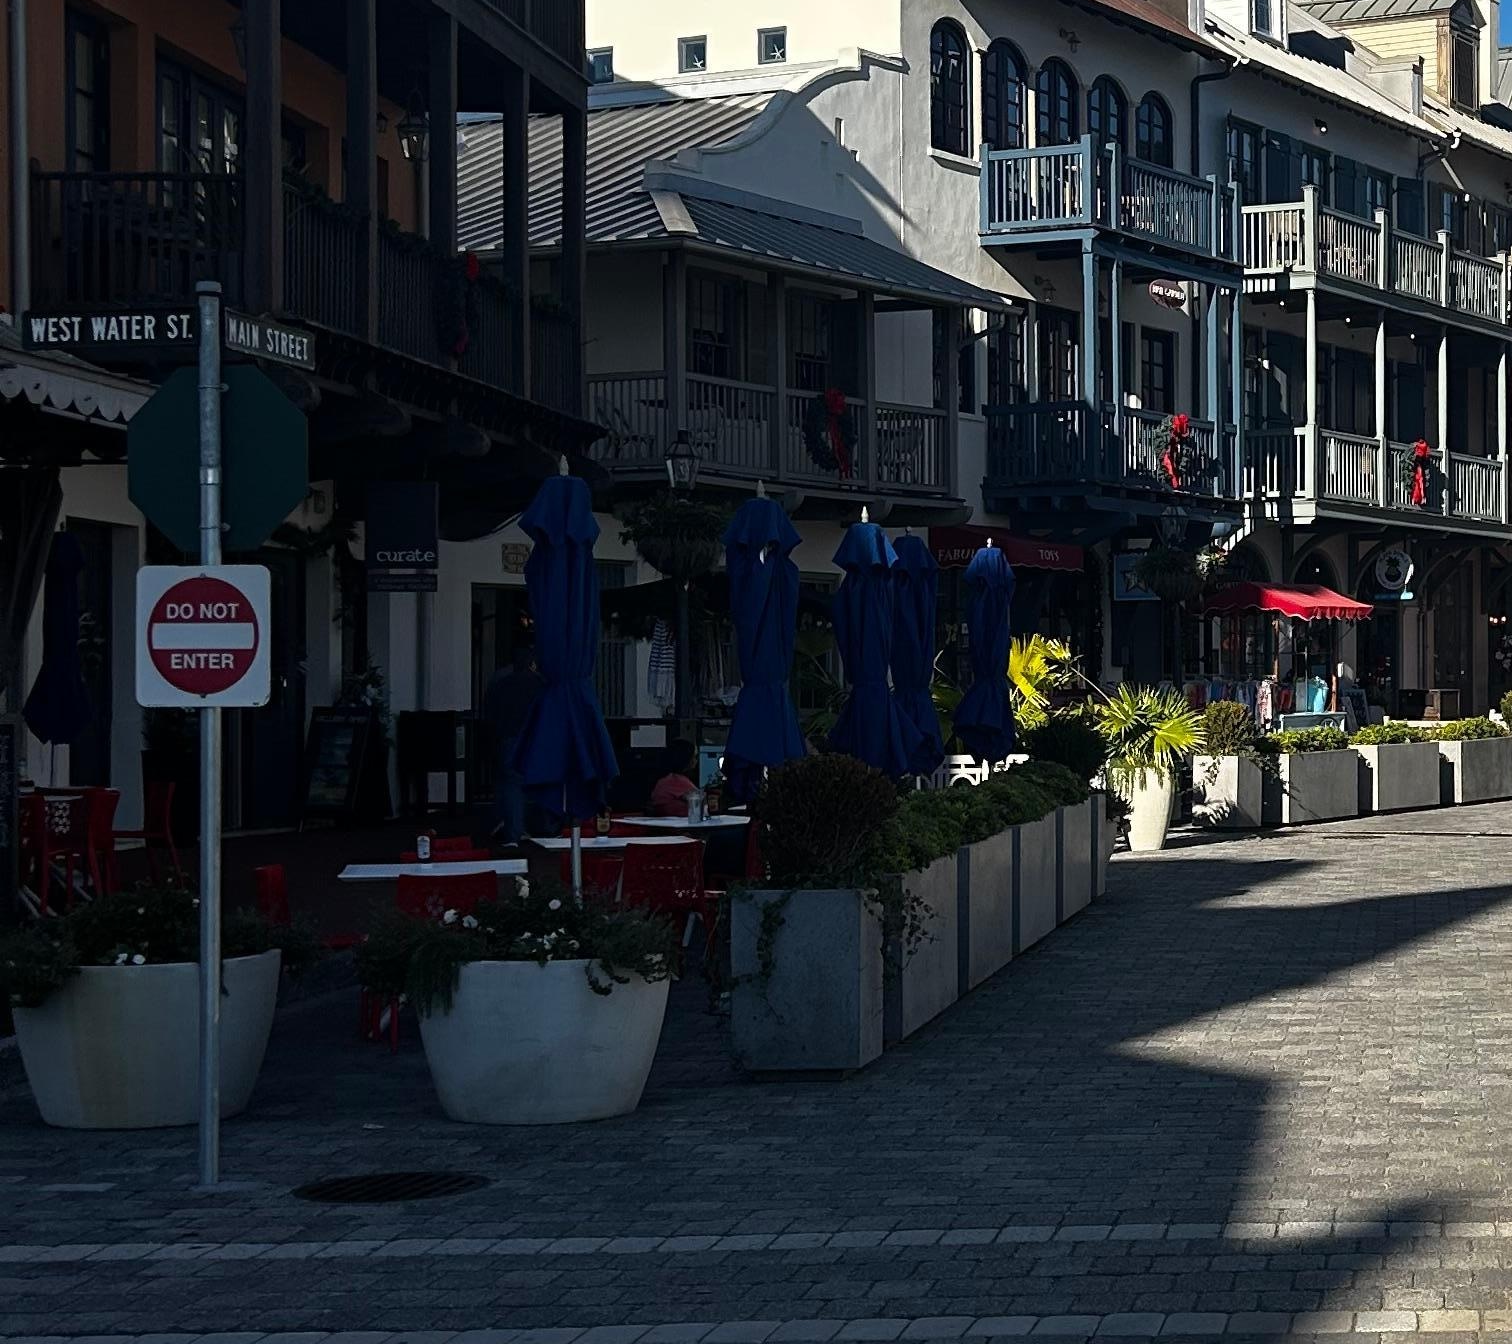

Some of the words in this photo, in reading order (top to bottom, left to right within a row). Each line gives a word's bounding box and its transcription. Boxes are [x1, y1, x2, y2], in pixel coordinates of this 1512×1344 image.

[30, 316, 82, 343] WEST
[90, 314, 156, 341] WATER
[166, 313, 193, 339] ST.
[228, 317, 260, 349] MAIN
[266, 327, 309, 361] STREET
[376, 548, 437, 563] curate
[166, 602, 194, 619] DO
[199, 602, 240, 619] NOT
[170, 652, 235, 670] ENTER
